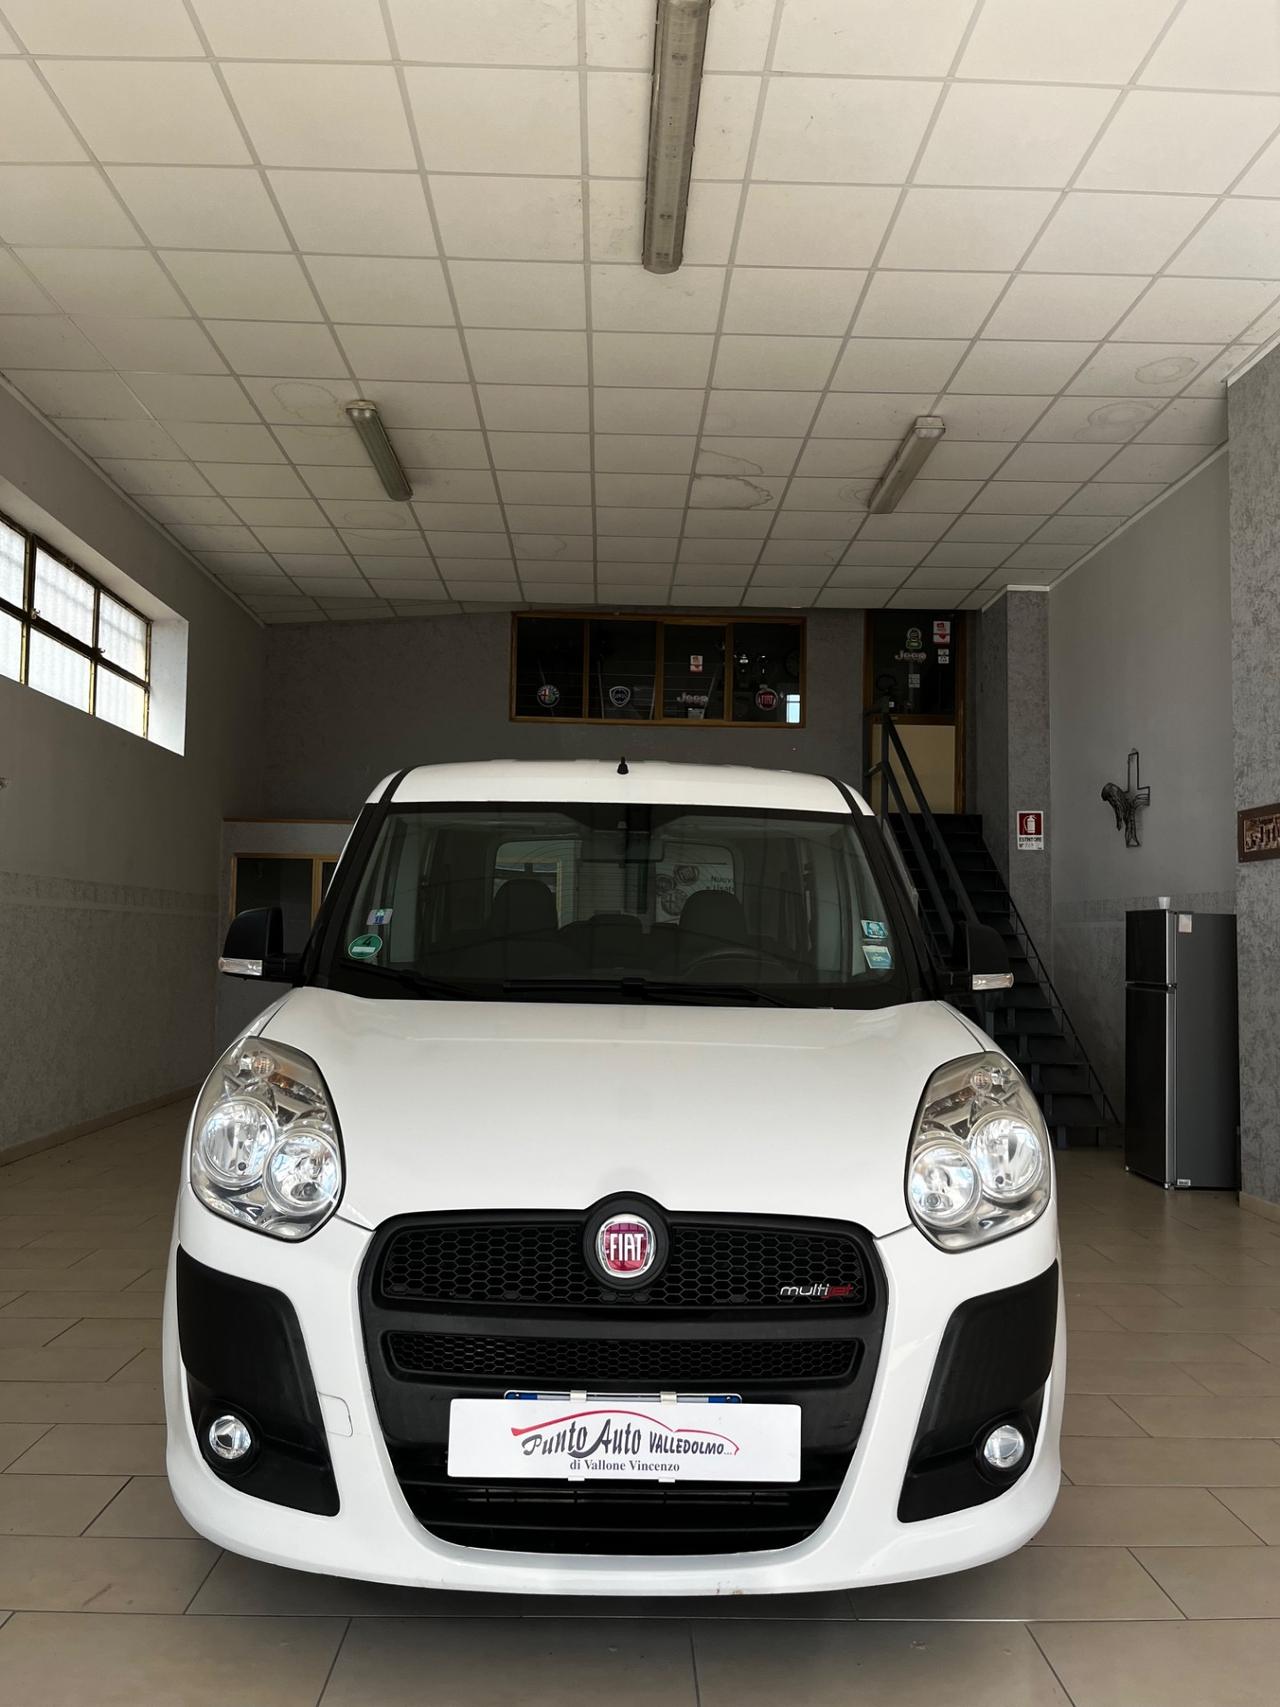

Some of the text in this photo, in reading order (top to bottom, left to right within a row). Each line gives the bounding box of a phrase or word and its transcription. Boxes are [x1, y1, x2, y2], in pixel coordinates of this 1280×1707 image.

[610, 1233, 644, 1261] FIAT
[780, 1283, 853, 1299] multijet
[521, 1418, 725, 1458] Punto Auto VALLEDOLMO
[569, 1459, 680, 1472] di Vallone Vincenzo
